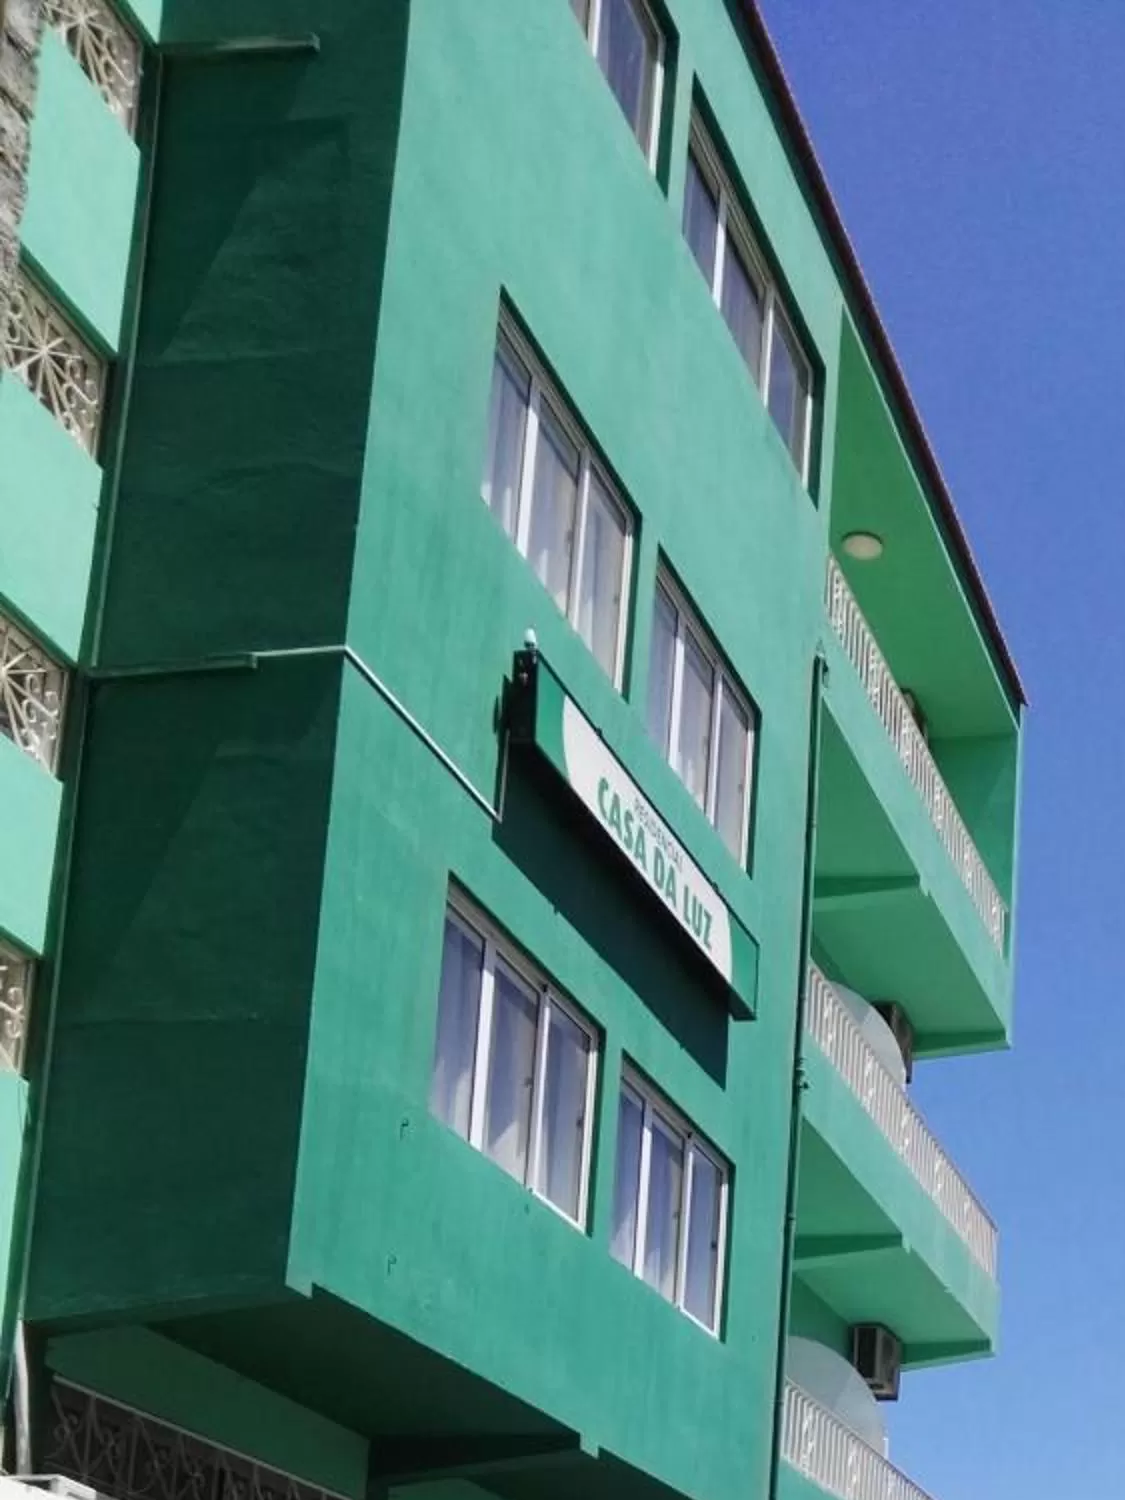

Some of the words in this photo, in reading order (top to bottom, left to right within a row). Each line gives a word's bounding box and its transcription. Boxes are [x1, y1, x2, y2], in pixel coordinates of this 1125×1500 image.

[598, 777, 647, 872] CASA
[653, 845, 677, 908] DA
[683, 884, 713, 950] LUZ
